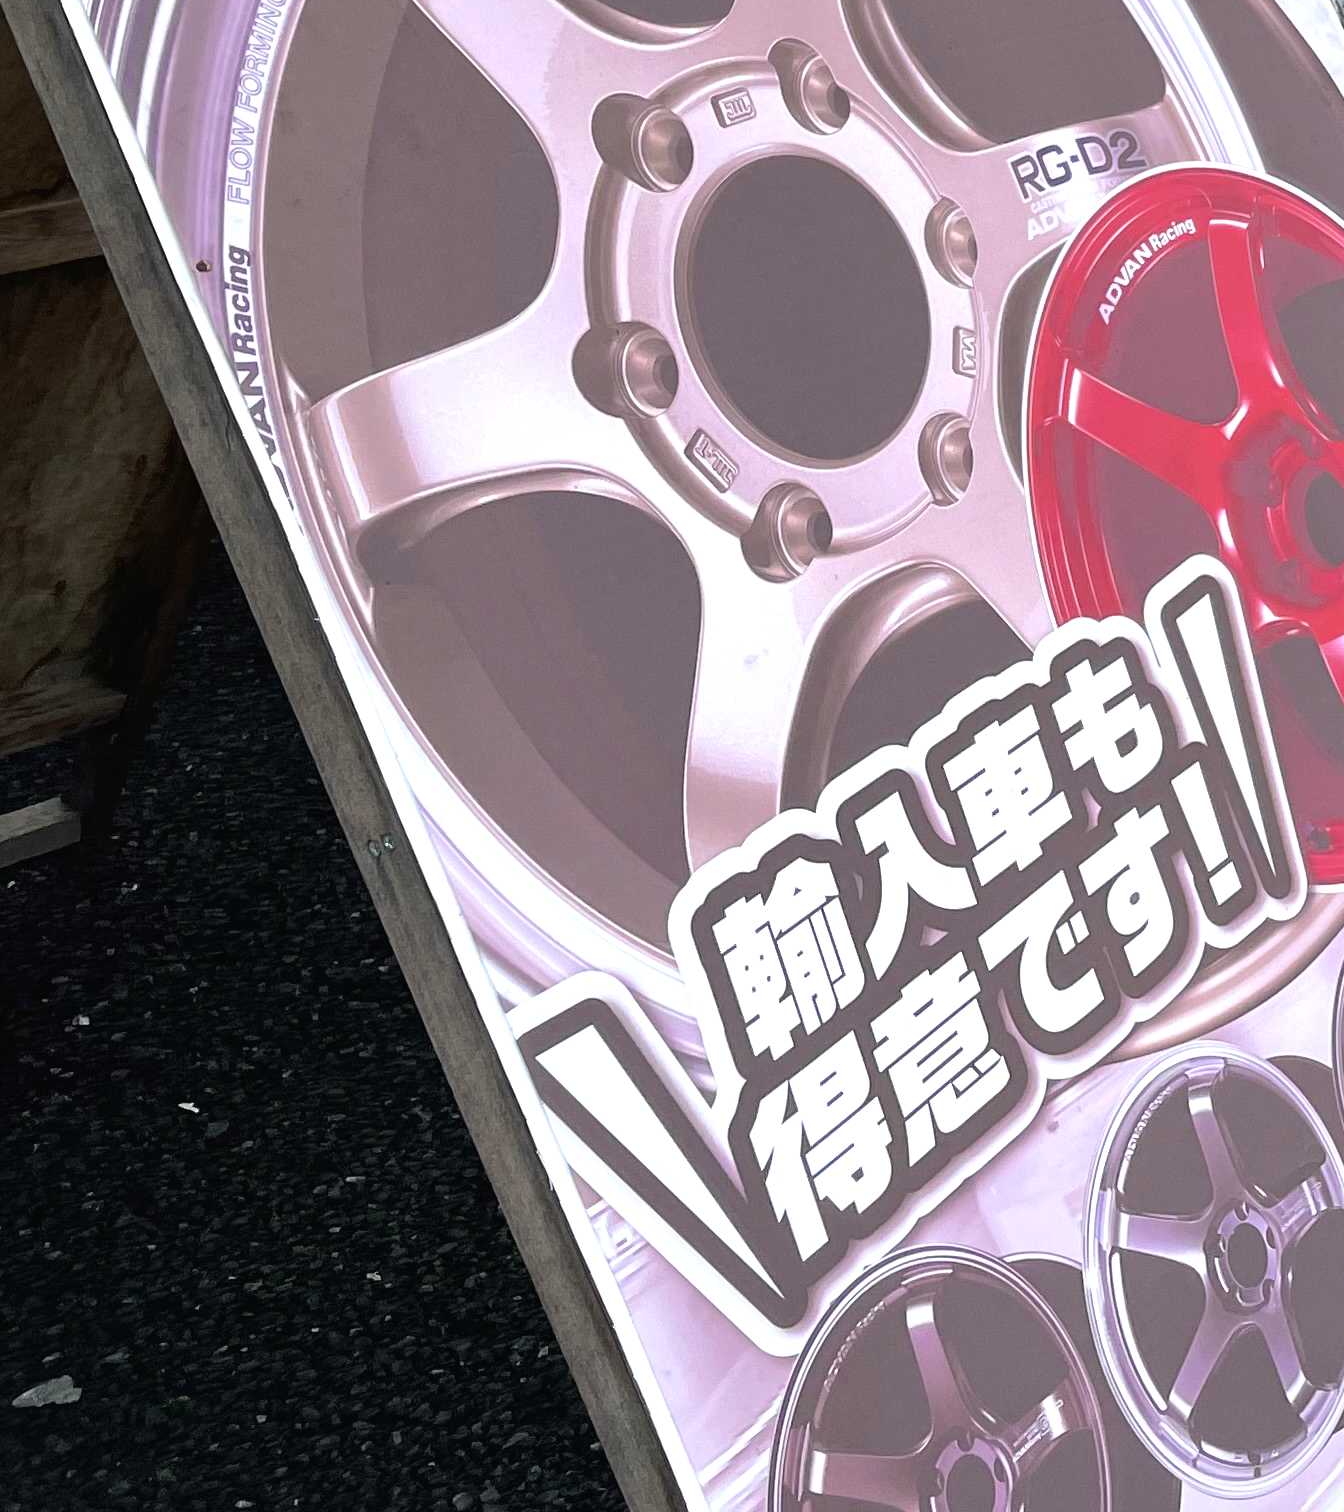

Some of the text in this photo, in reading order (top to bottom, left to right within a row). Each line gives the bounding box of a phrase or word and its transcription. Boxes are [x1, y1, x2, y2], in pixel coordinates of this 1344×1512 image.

[225, 113, 257, 205] FLOW
[1010, 131, 1147, 200] RG-D2
[225, 245, 257, 357] Racing
[1098, 218, 1196, 325] ADVAN Racing
[713, 657, 1165, 1061] 輸入車も
[751, 762, 1242, 1263] 得意です!
